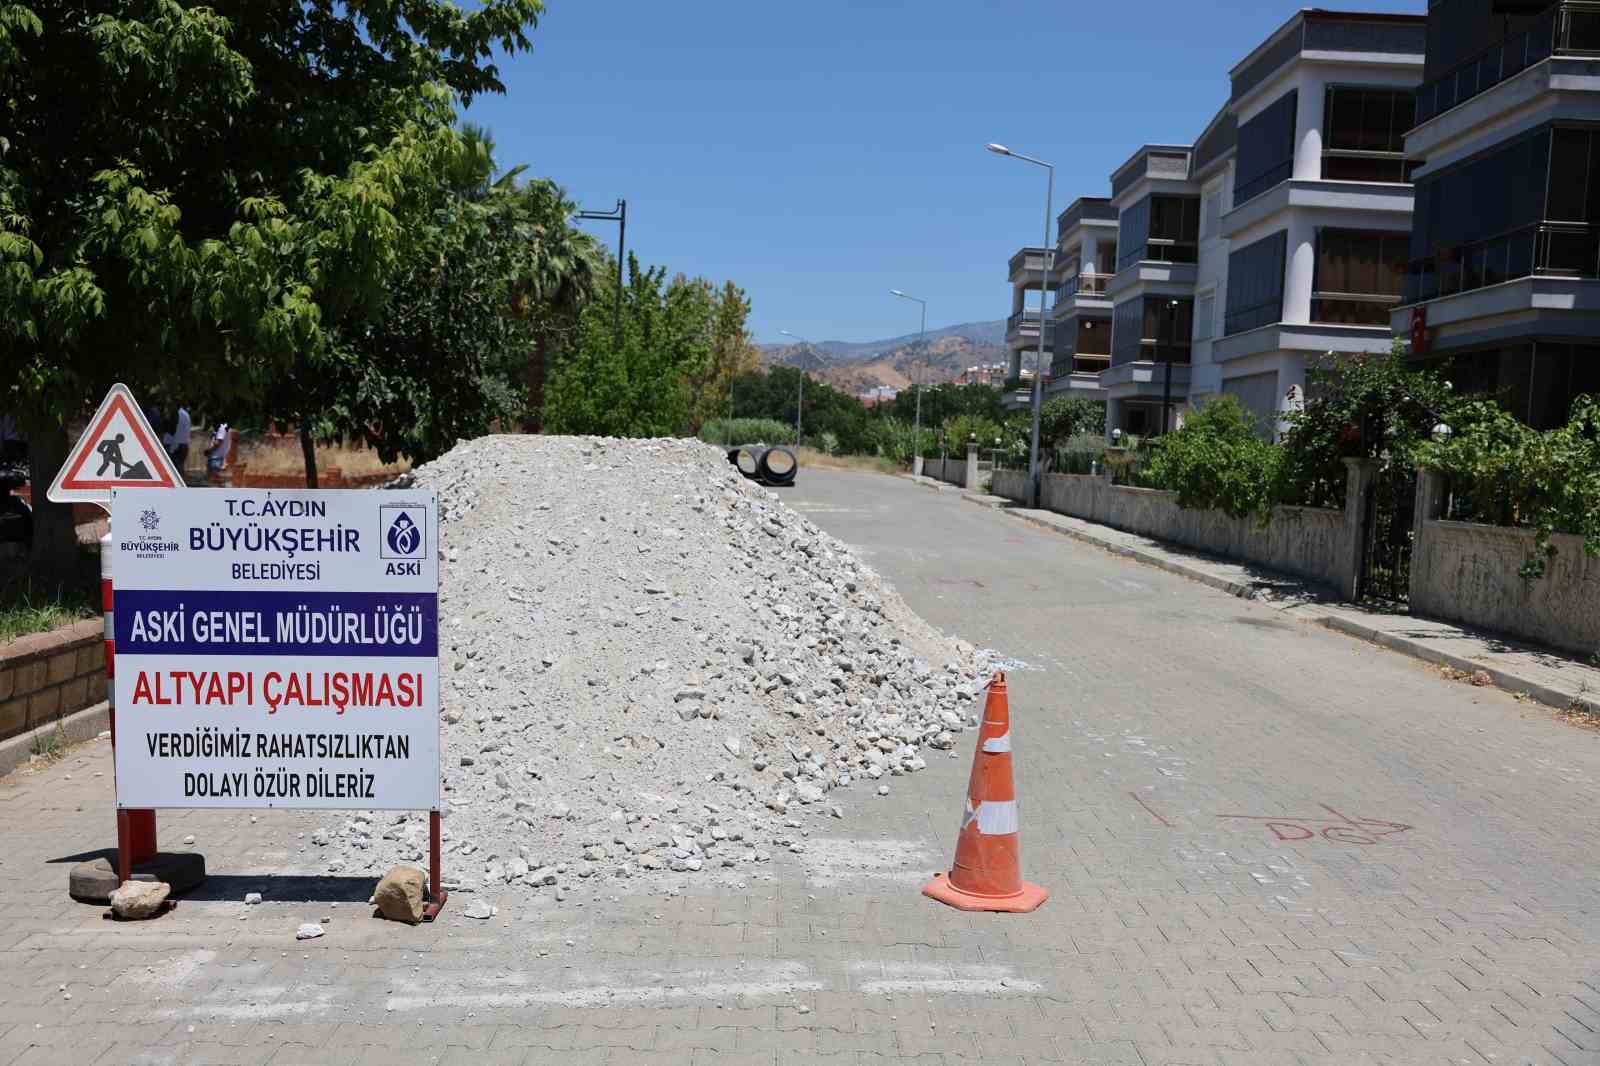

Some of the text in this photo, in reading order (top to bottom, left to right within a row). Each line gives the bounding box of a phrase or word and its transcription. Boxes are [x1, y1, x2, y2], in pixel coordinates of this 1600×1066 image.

[120, 541, 180, 553] BÜYÜKŞEHİR
[189, 522, 361, 558] BÜYÜKŞEHİR
[231, 560, 320, 580] BELEDİYESİ
[385, 560, 421, 576] ASKİ
[130, 603, 423, 645] ASKİ GENEL MÜDÜRLÜĞÜ
[131, 671, 423, 715] ALTYAPI ÇALIŞMASI
[146, 727, 409, 760] VERDİĞİMİZ RAHATSIZLIKTAN
[184, 767, 375, 798] DOLAYI ÖZÜR DİLERİZ
